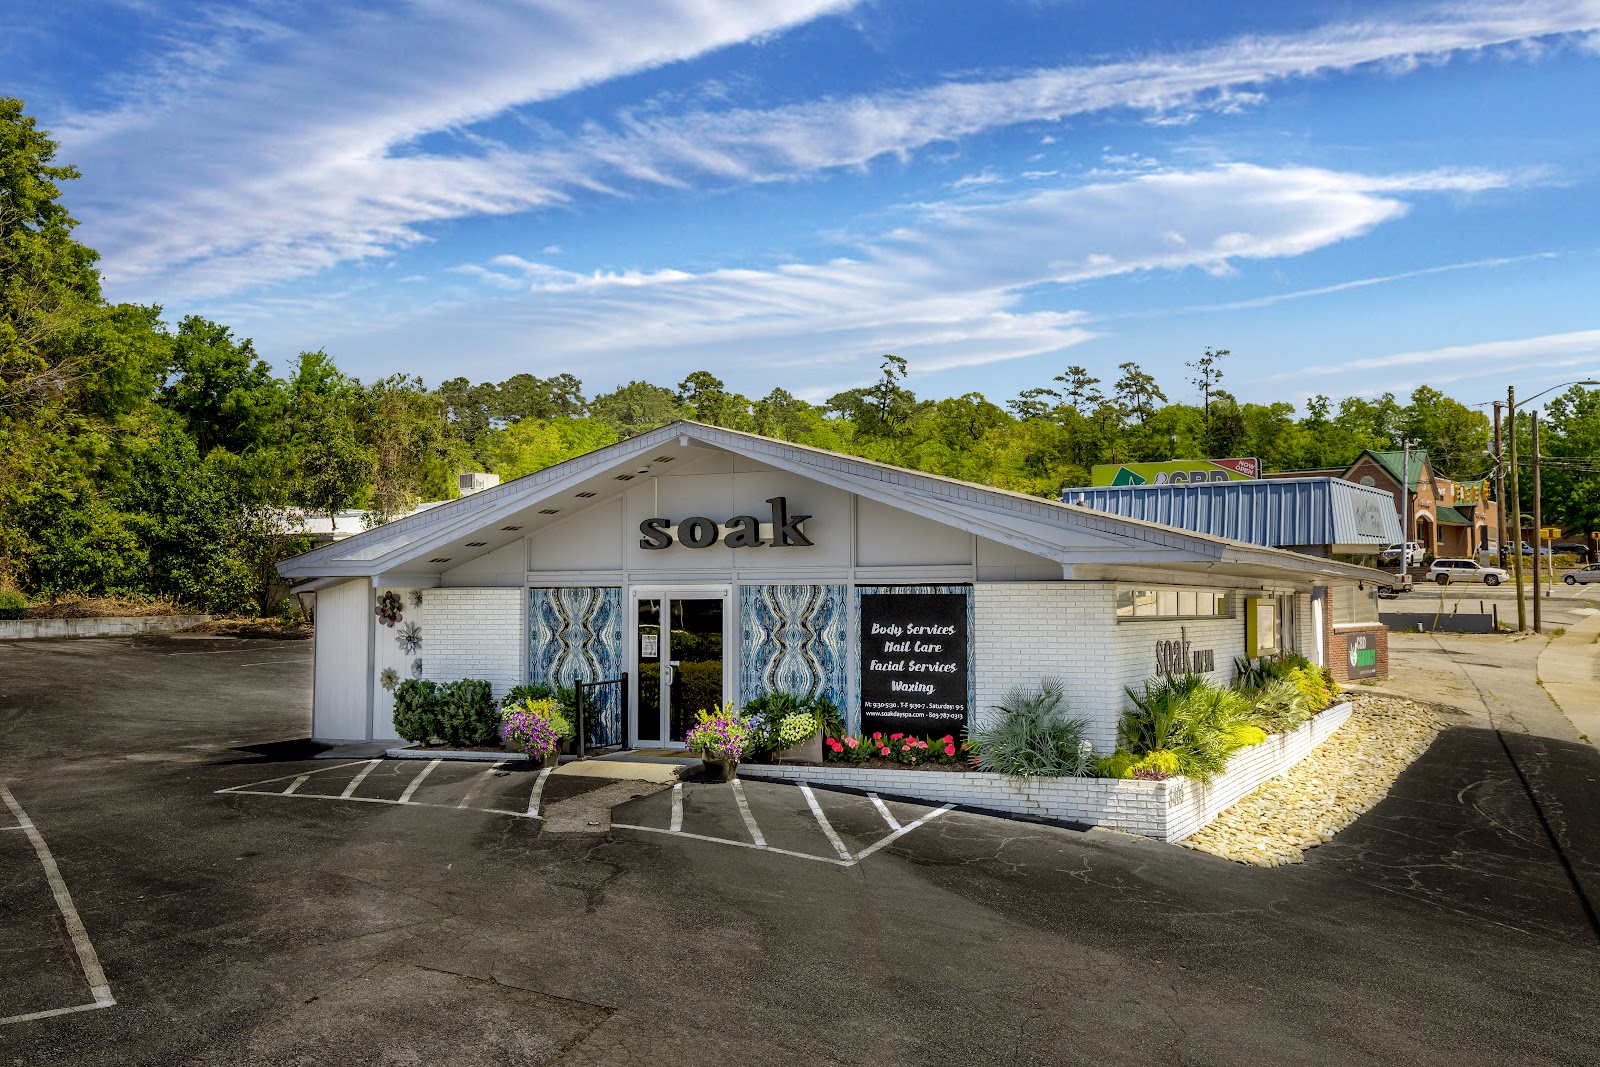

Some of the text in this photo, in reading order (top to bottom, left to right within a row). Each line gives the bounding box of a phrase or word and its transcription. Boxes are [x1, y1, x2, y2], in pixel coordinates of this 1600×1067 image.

[1235, 465, 1254, 475] OPEN
[1239, 460, 1256, 469] NOW
[639, 496, 814, 550] soak
[871, 623, 956, 637] Body Services
[884, 641, 943, 652] Nail Care
[1156, 626, 1192, 677] soak
[870, 660, 958, 673] Facial Services
[891, 681, 936, 695] Waxing
